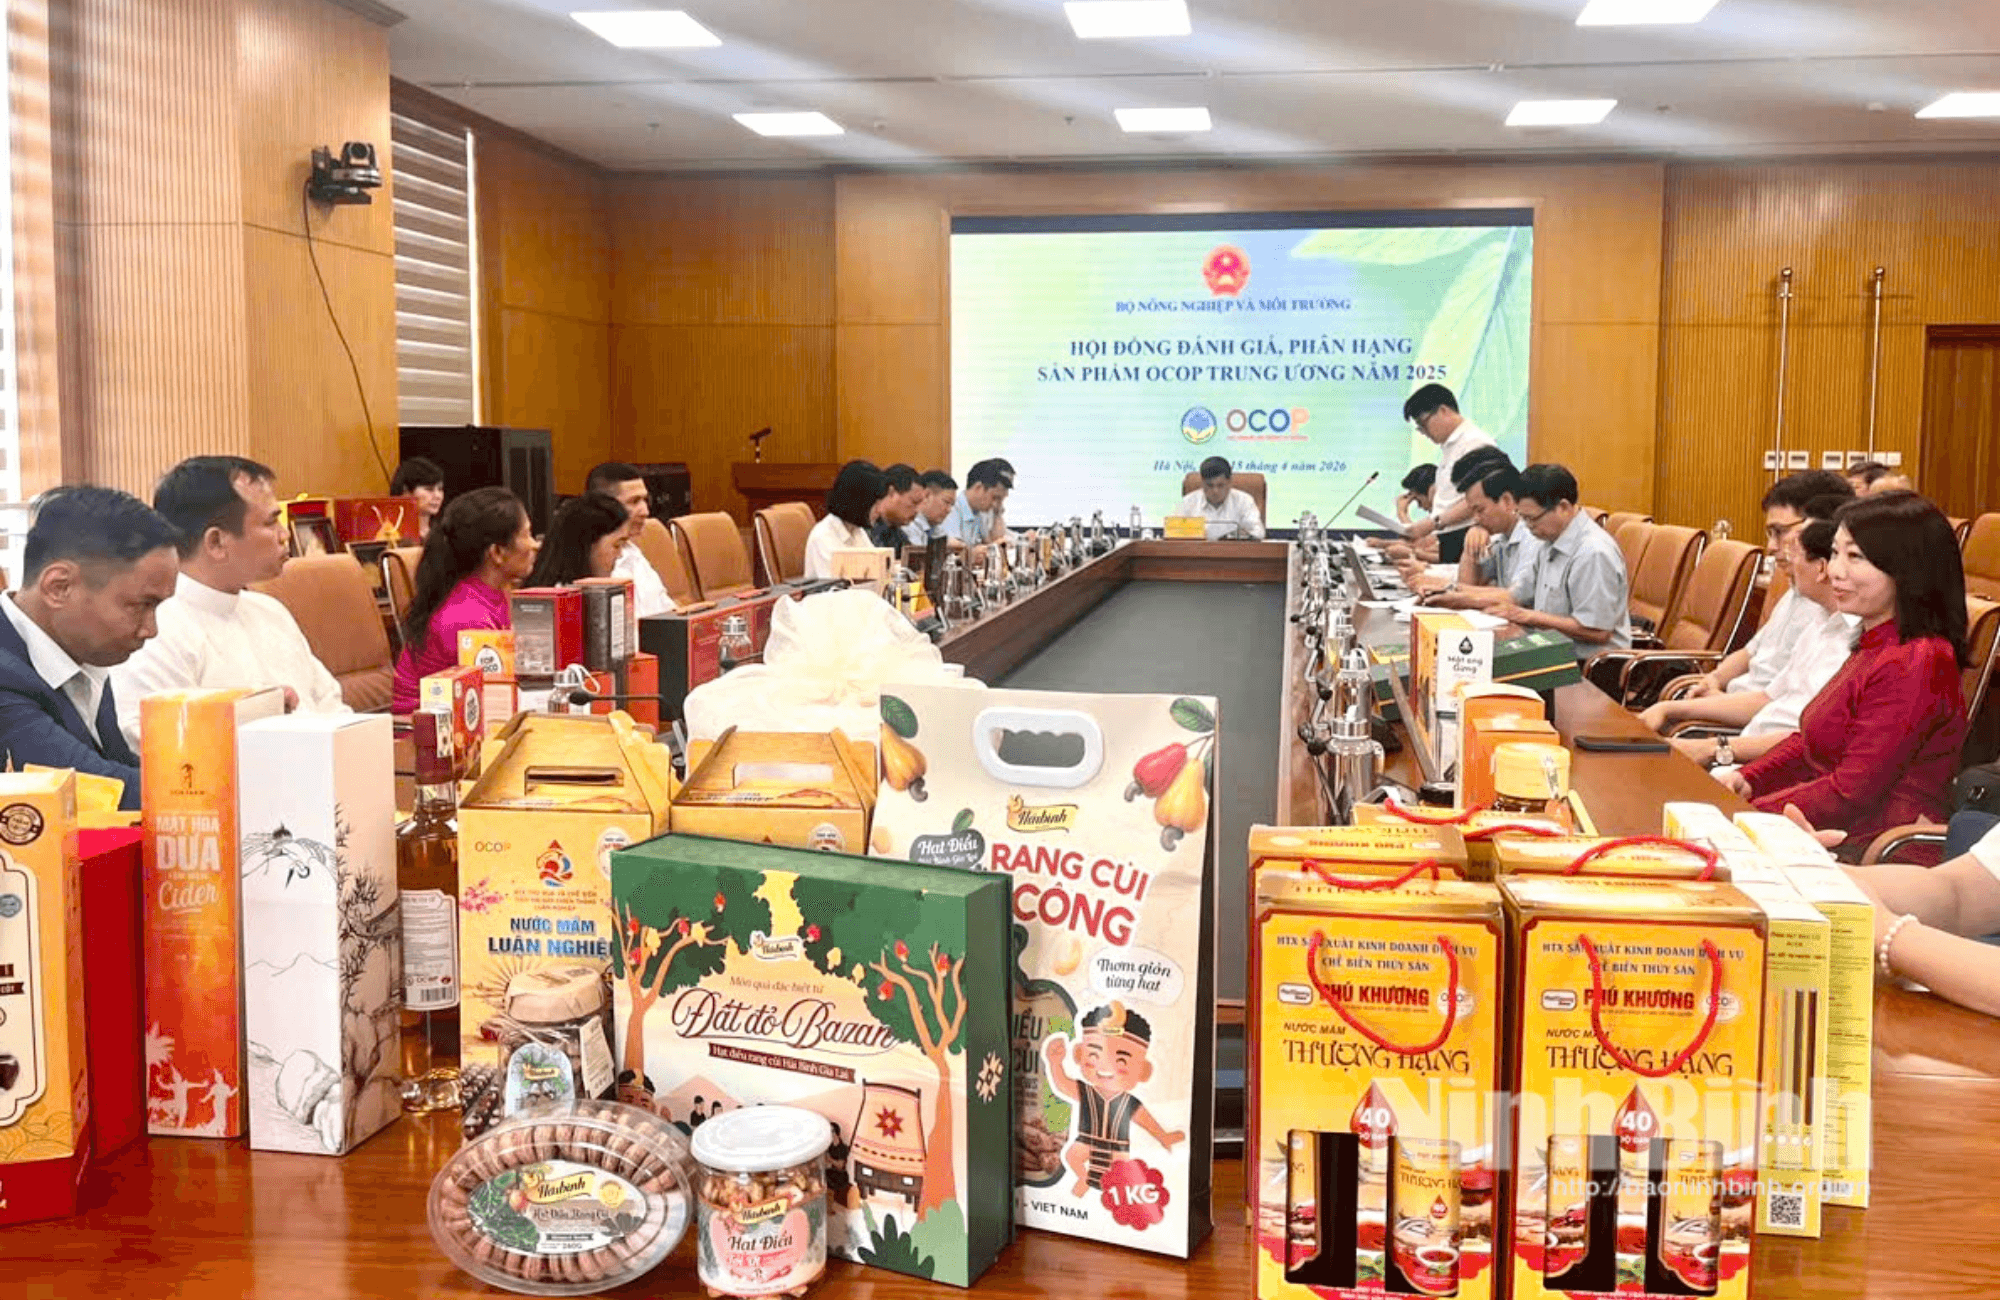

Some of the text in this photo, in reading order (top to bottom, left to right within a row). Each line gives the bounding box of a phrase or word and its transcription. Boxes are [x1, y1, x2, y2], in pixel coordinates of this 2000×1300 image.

[1071, 339, 1106, 359] HỘI
[1177, 335, 1234, 355] ĐÁNH
[1241, 334, 1283, 357] GIÁ,
[1289, 334, 1345, 354] PHÂN
[1353, 338, 1412, 358] HẠNG
[1037, 362, 1075, 382] SẢN
[1146, 366, 1203, 382] OCOP
[1207, 365, 1278, 382] TRUNG
[1284, 363, 1345, 381] ƯƠNG
[1352, 361, 1399, 381] NĂM
[1406, 365, 1446, 380] 2025
[1226, 407, 1310, 434] OCOP
[991, 843, 1149, 901] RANG CỦI
[159, 881, 217, 911] Cider
[510, 916, 595, 933] NƯỚC MẮM
[1013, 882, 1135, 947] CÔNG
[488, 935, 541, 956] LUẬN
[1277, 936, 1298, 946] HTX
[1358, 940, 1386, 950] KINH
[1390, 941, 1429, 954] DOANH
[1542, 943, 1563, 953] HTX
[1625, 945, 1651, 955] KINH
[1657, 946, 1695, 957] DOANH
[1097, 957, 1171, 977] Thơm giòn
[1613, 961, 1638, 973] BIẾN
[1105, 975, 1135, 991] từng
[1359, 984, 1430, 1007] KHƯƠNG
[1624, 988, 1694, 1010] KHƯƠNG
[671, 988, 893, 1049] Đất đỏ Bazan
[1284, 1021, 1346, 1035] NƯỚC MẮM
[1546, 1028, 1580, 1038] NƯỚC
[1282, 1039, 1390, 1072] THƯỢNG
[1359, 1108, 1391, 1129] 40
[1621, 1111, 1651, 1132] 40
[1109, 1184, 1160, 1206] 1 KG
[1031, 1200, 1056, 1214] VIET
[1060, 1205, 1089, 1220] NAM
